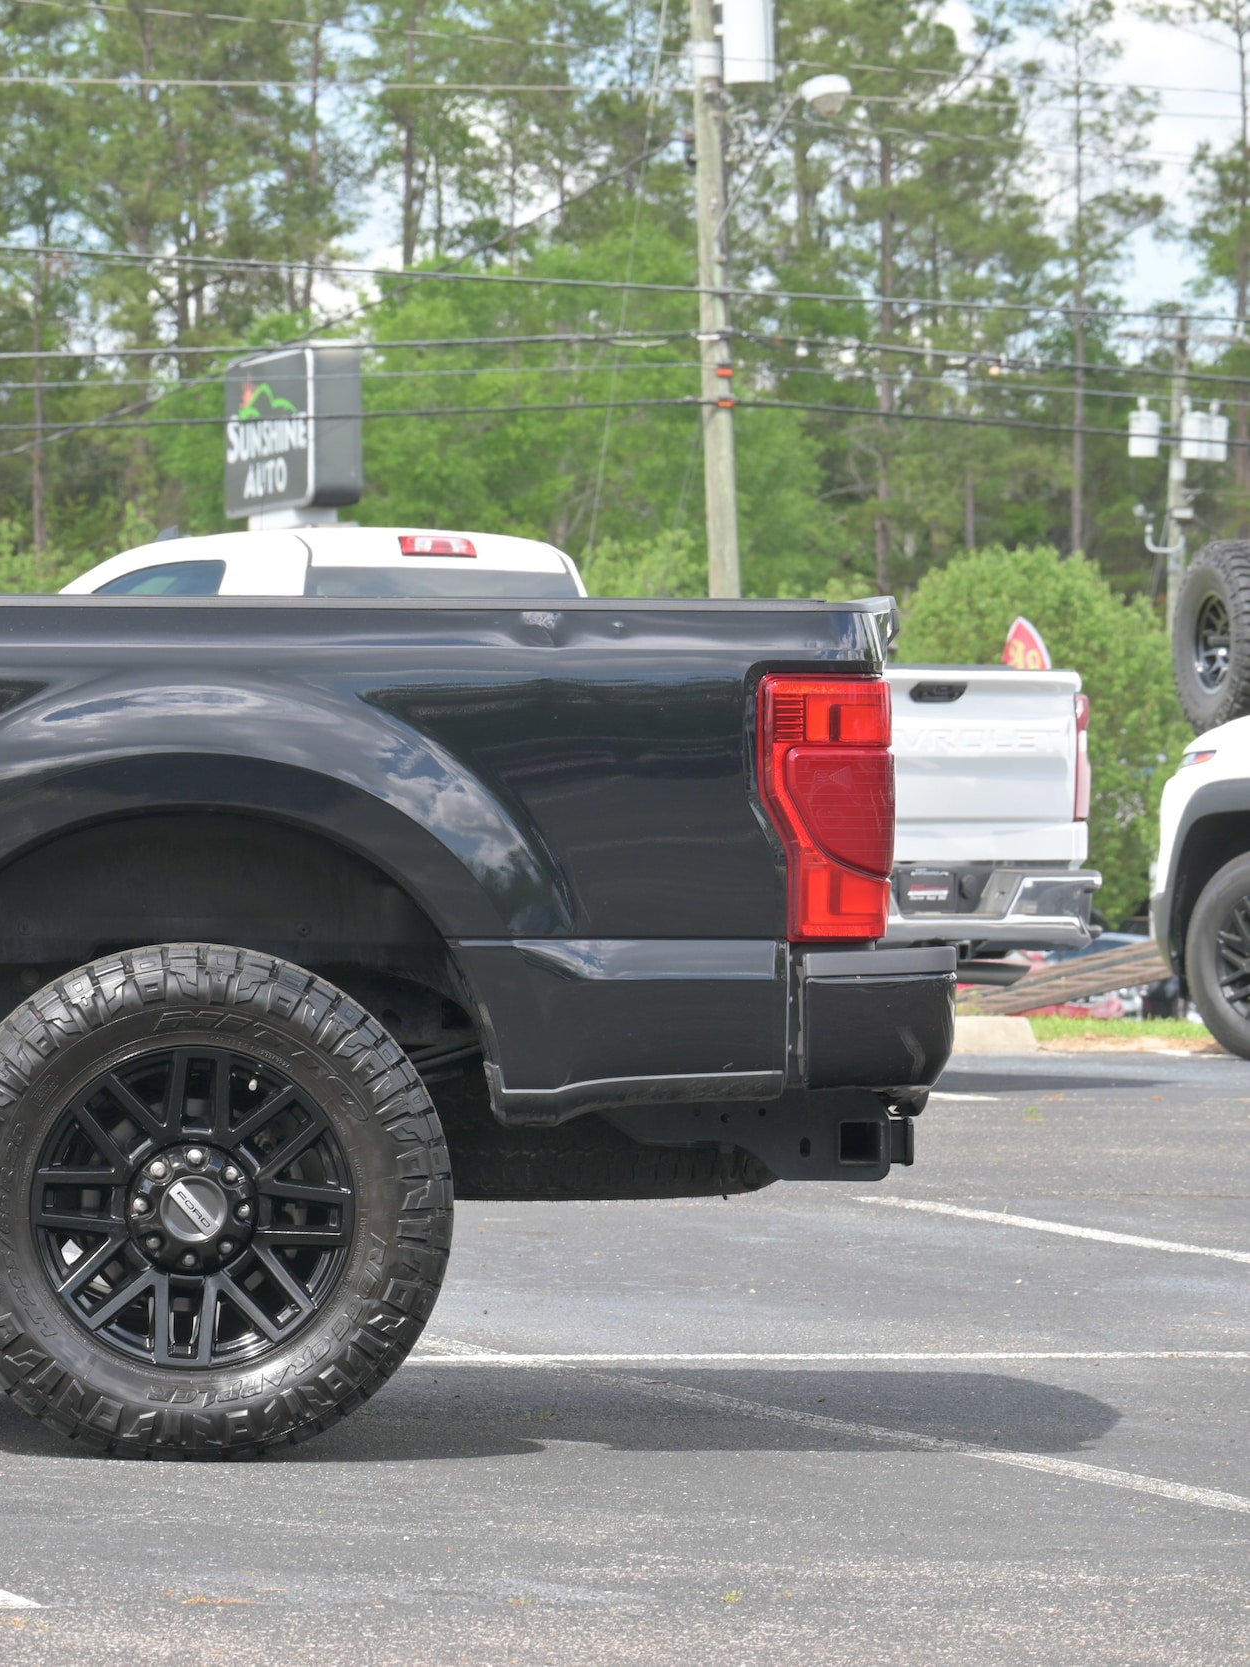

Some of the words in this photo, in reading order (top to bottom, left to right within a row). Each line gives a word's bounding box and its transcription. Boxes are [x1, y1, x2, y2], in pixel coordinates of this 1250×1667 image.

[227, 412, 308, 464] SUNSHINE
[243, 456, 288, 499] AUTO
[893, 728, 1062, 752] VROLET
[176, 1190, 211, 1229] FORD
[330, 1232, 388, 1342] RIDGE
[146, 1335, 332, 1408] GRAPPLER
